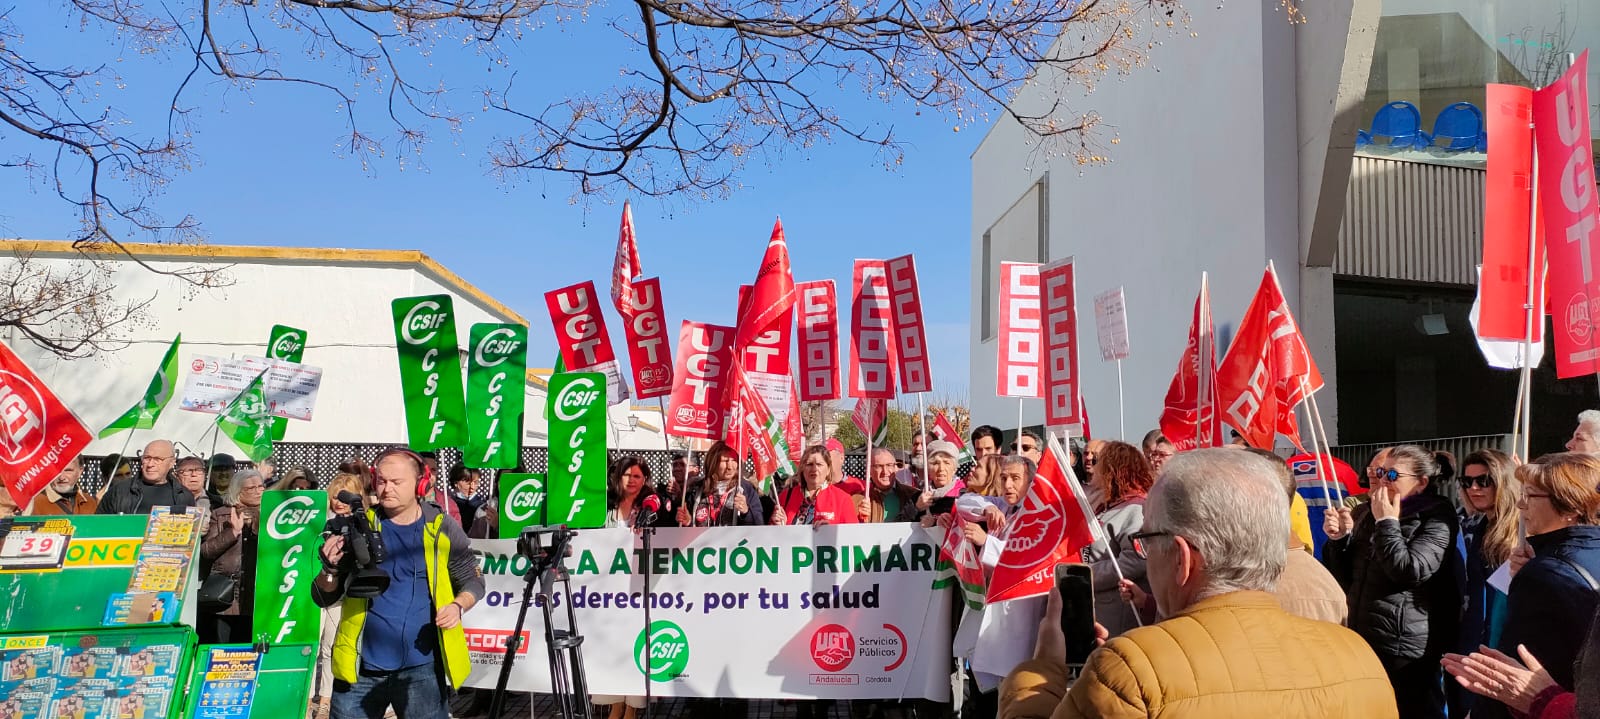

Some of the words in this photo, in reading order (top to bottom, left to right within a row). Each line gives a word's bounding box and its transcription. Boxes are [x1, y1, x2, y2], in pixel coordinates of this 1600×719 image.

[1556, 72, 1597, 286] UGT
[278, 340, 301, 353] CSIF
[411, 313, 447, 329] CSIF
[559, 288, 601, 365] UGT
[632, 285, 662, 364] UGT
[804, 286, 832, 396] CCOO
[858, 267, 890, 391] CCOO
[890, 259, 925, 391] CCOO
[1008, 266, 1040, 396] CCOO
[1047, 275, 1072, 417] CCOO
[484, 340, 520, 354] CSIF
[685, 326, 724, 405] UGT
[746, 330, 781, 373] GT
[422, 348, 446, 443] CSIF
[482, 372, 507, 462] CSIF
[563, 390, 599, 406] CSIF
[15, 434, 72, 493] www.ugt.es
[566, 425, 586, 522] CSIF
[280, 508, 319, 524] CSIF
[514, 493, 546, 508] CSIF
[608, 538, 779, 576] ATENCIÓN
[792, 544, 943, 575] PRIMARI
[275, 545, 303, 643] CSIF
[486, 591, 514, 608] or
[571, 586, 694, 613] derechos,
[703, 592, 750, 614] por
[758, 588, 789, 610] tu
[800, 583, 880, 610] salud
[10, 637, 44, 648] ONCE
[649, 641, 686, 659] CSIF
[816, 631, 849, 651] UGT
[859, 637, 899, 646] Servicios
[859, 648, 896, 657] Públicos
